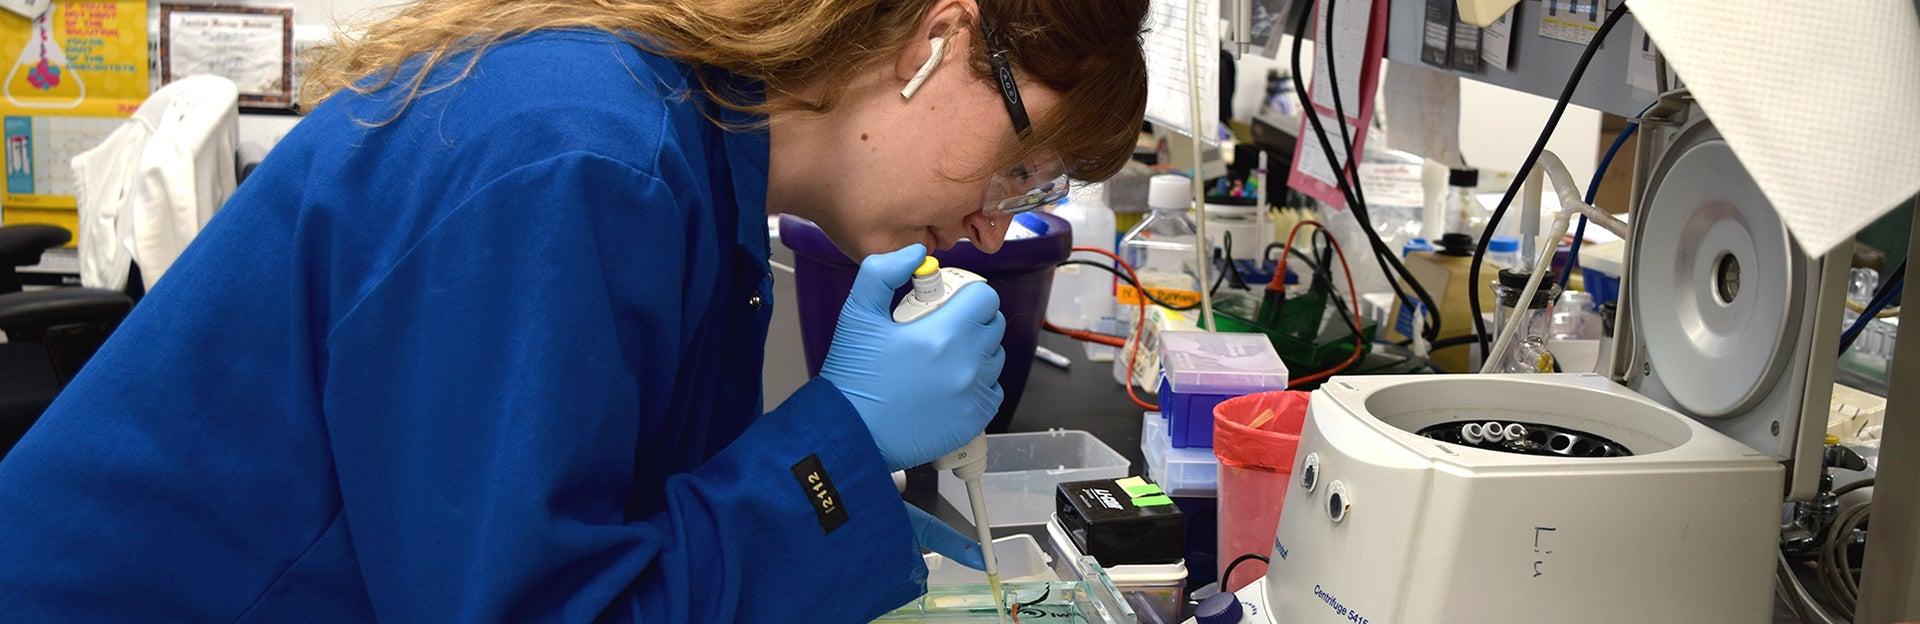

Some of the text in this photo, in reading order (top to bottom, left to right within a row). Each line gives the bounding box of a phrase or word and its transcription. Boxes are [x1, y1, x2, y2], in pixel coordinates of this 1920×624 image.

[958, 451, 968, 460] 20
[808, 471, 834, 509] 2112
[1534, 527, 1556, 578] Liu
[1314, 584, 1348, 616] Centrifuge
